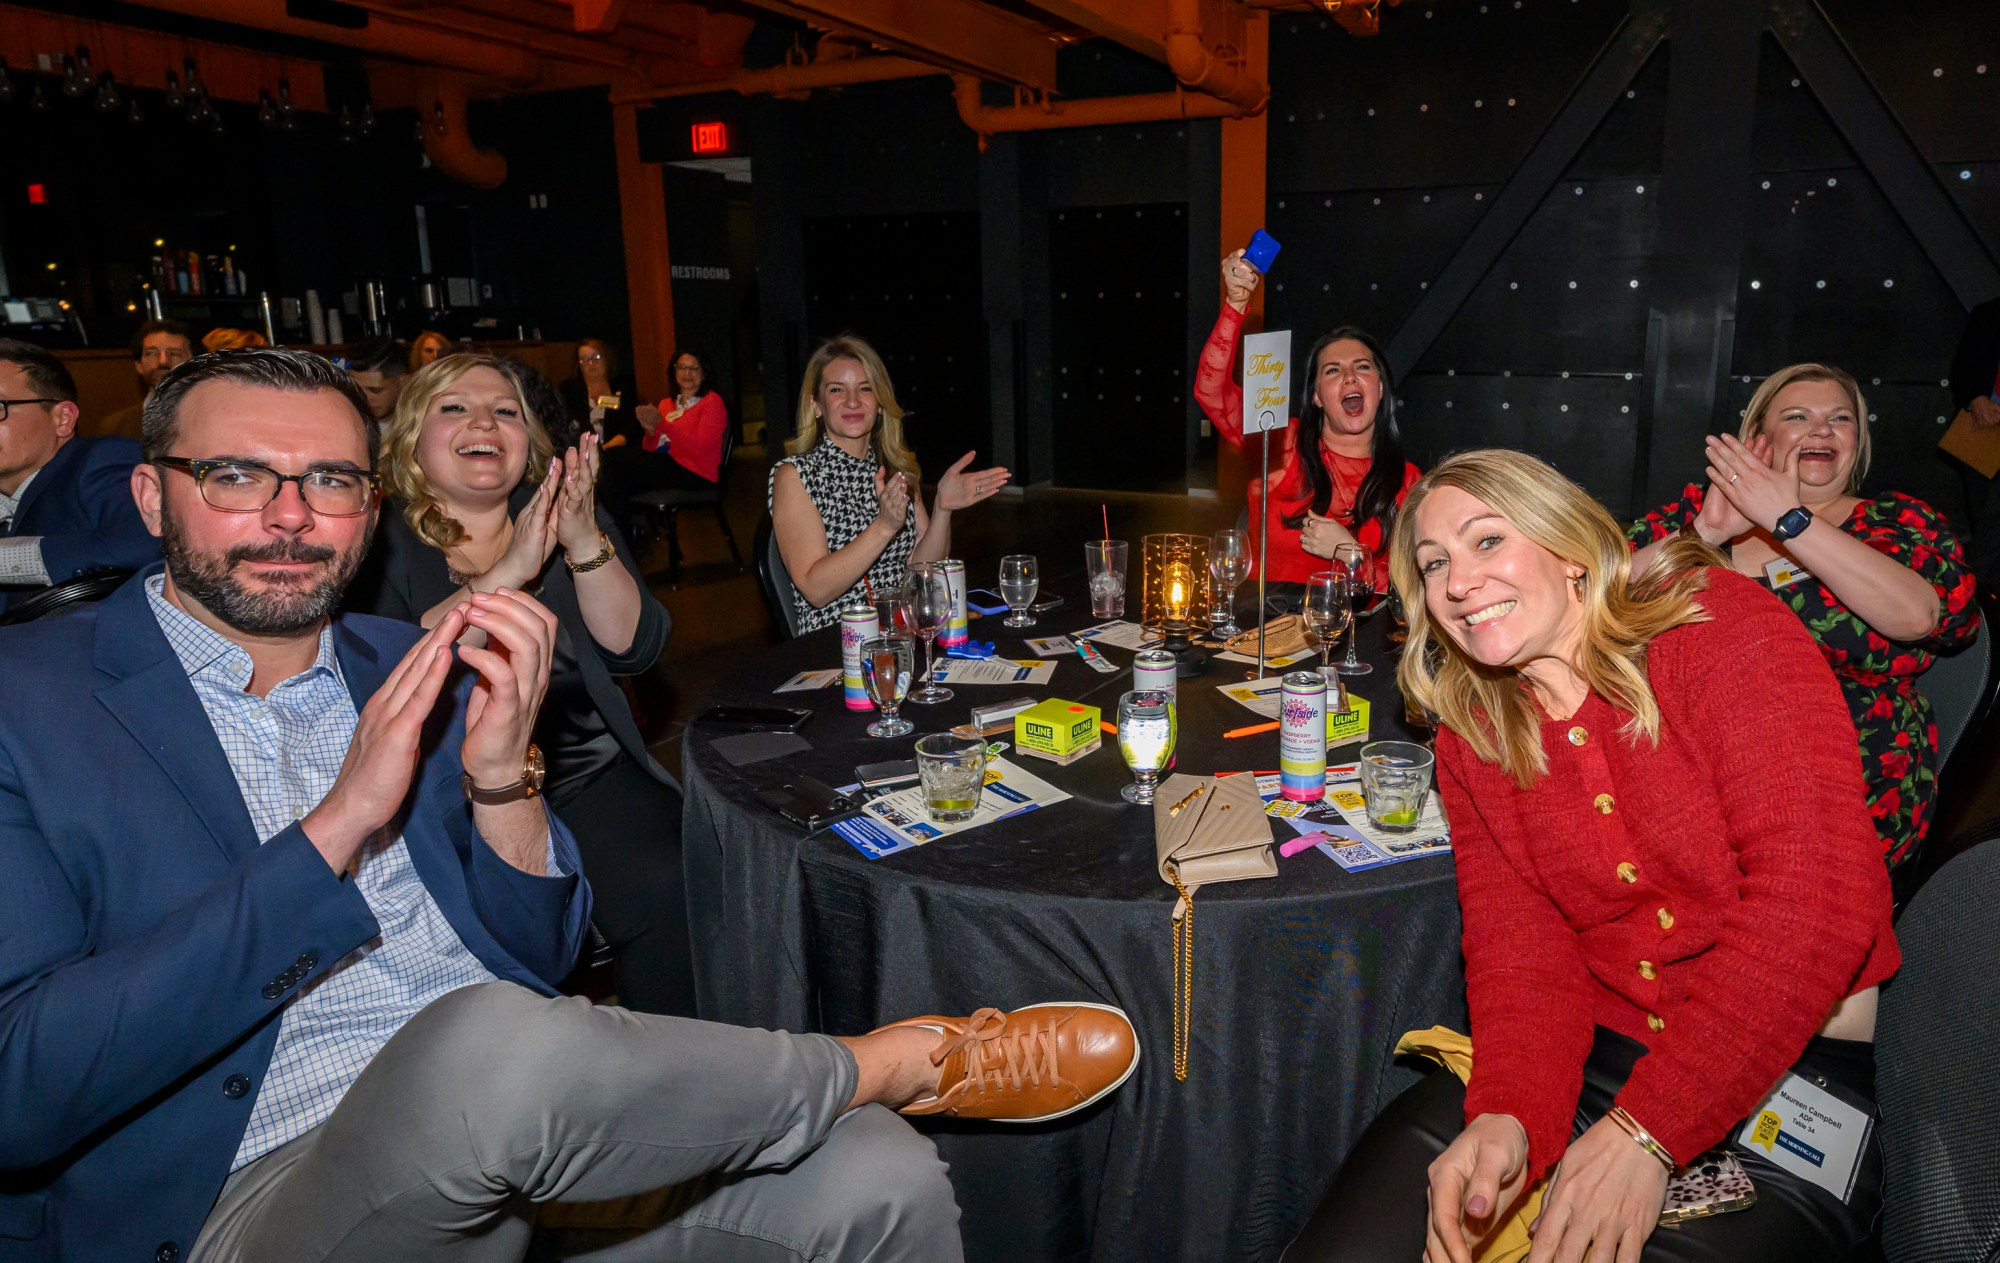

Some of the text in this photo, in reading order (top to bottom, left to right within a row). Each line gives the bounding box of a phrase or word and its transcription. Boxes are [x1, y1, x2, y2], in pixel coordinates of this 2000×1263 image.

[698, 125, 721, 150] EXIT
[671, 265, 730, 280] RESTROOMS
[1247, 353, 1285, 381] Thirty
[1254, 387, 1286, 410] Four
[1281, 702, 1319, 718] Surfside
[1335, 711, 1358, 725] ULINE
[1027, 724, 1052, 738] ULINE
[1073, 719, 1092, 735] ULINE
[1283, 730, 1311, 738] RASPBERRY
[1780, 1090, 1842, 1130] Maureen Campbell
[1799, 1112, 1814, 1123] ADP
[1761, 1122, 1775, 1132] WORK
[1763, 1114, 1778, 1126] TOP
[1792, 1118, 1815, 1134] Table 34
[1779, 1135, 1821, 1162] THE MORNING CALL
